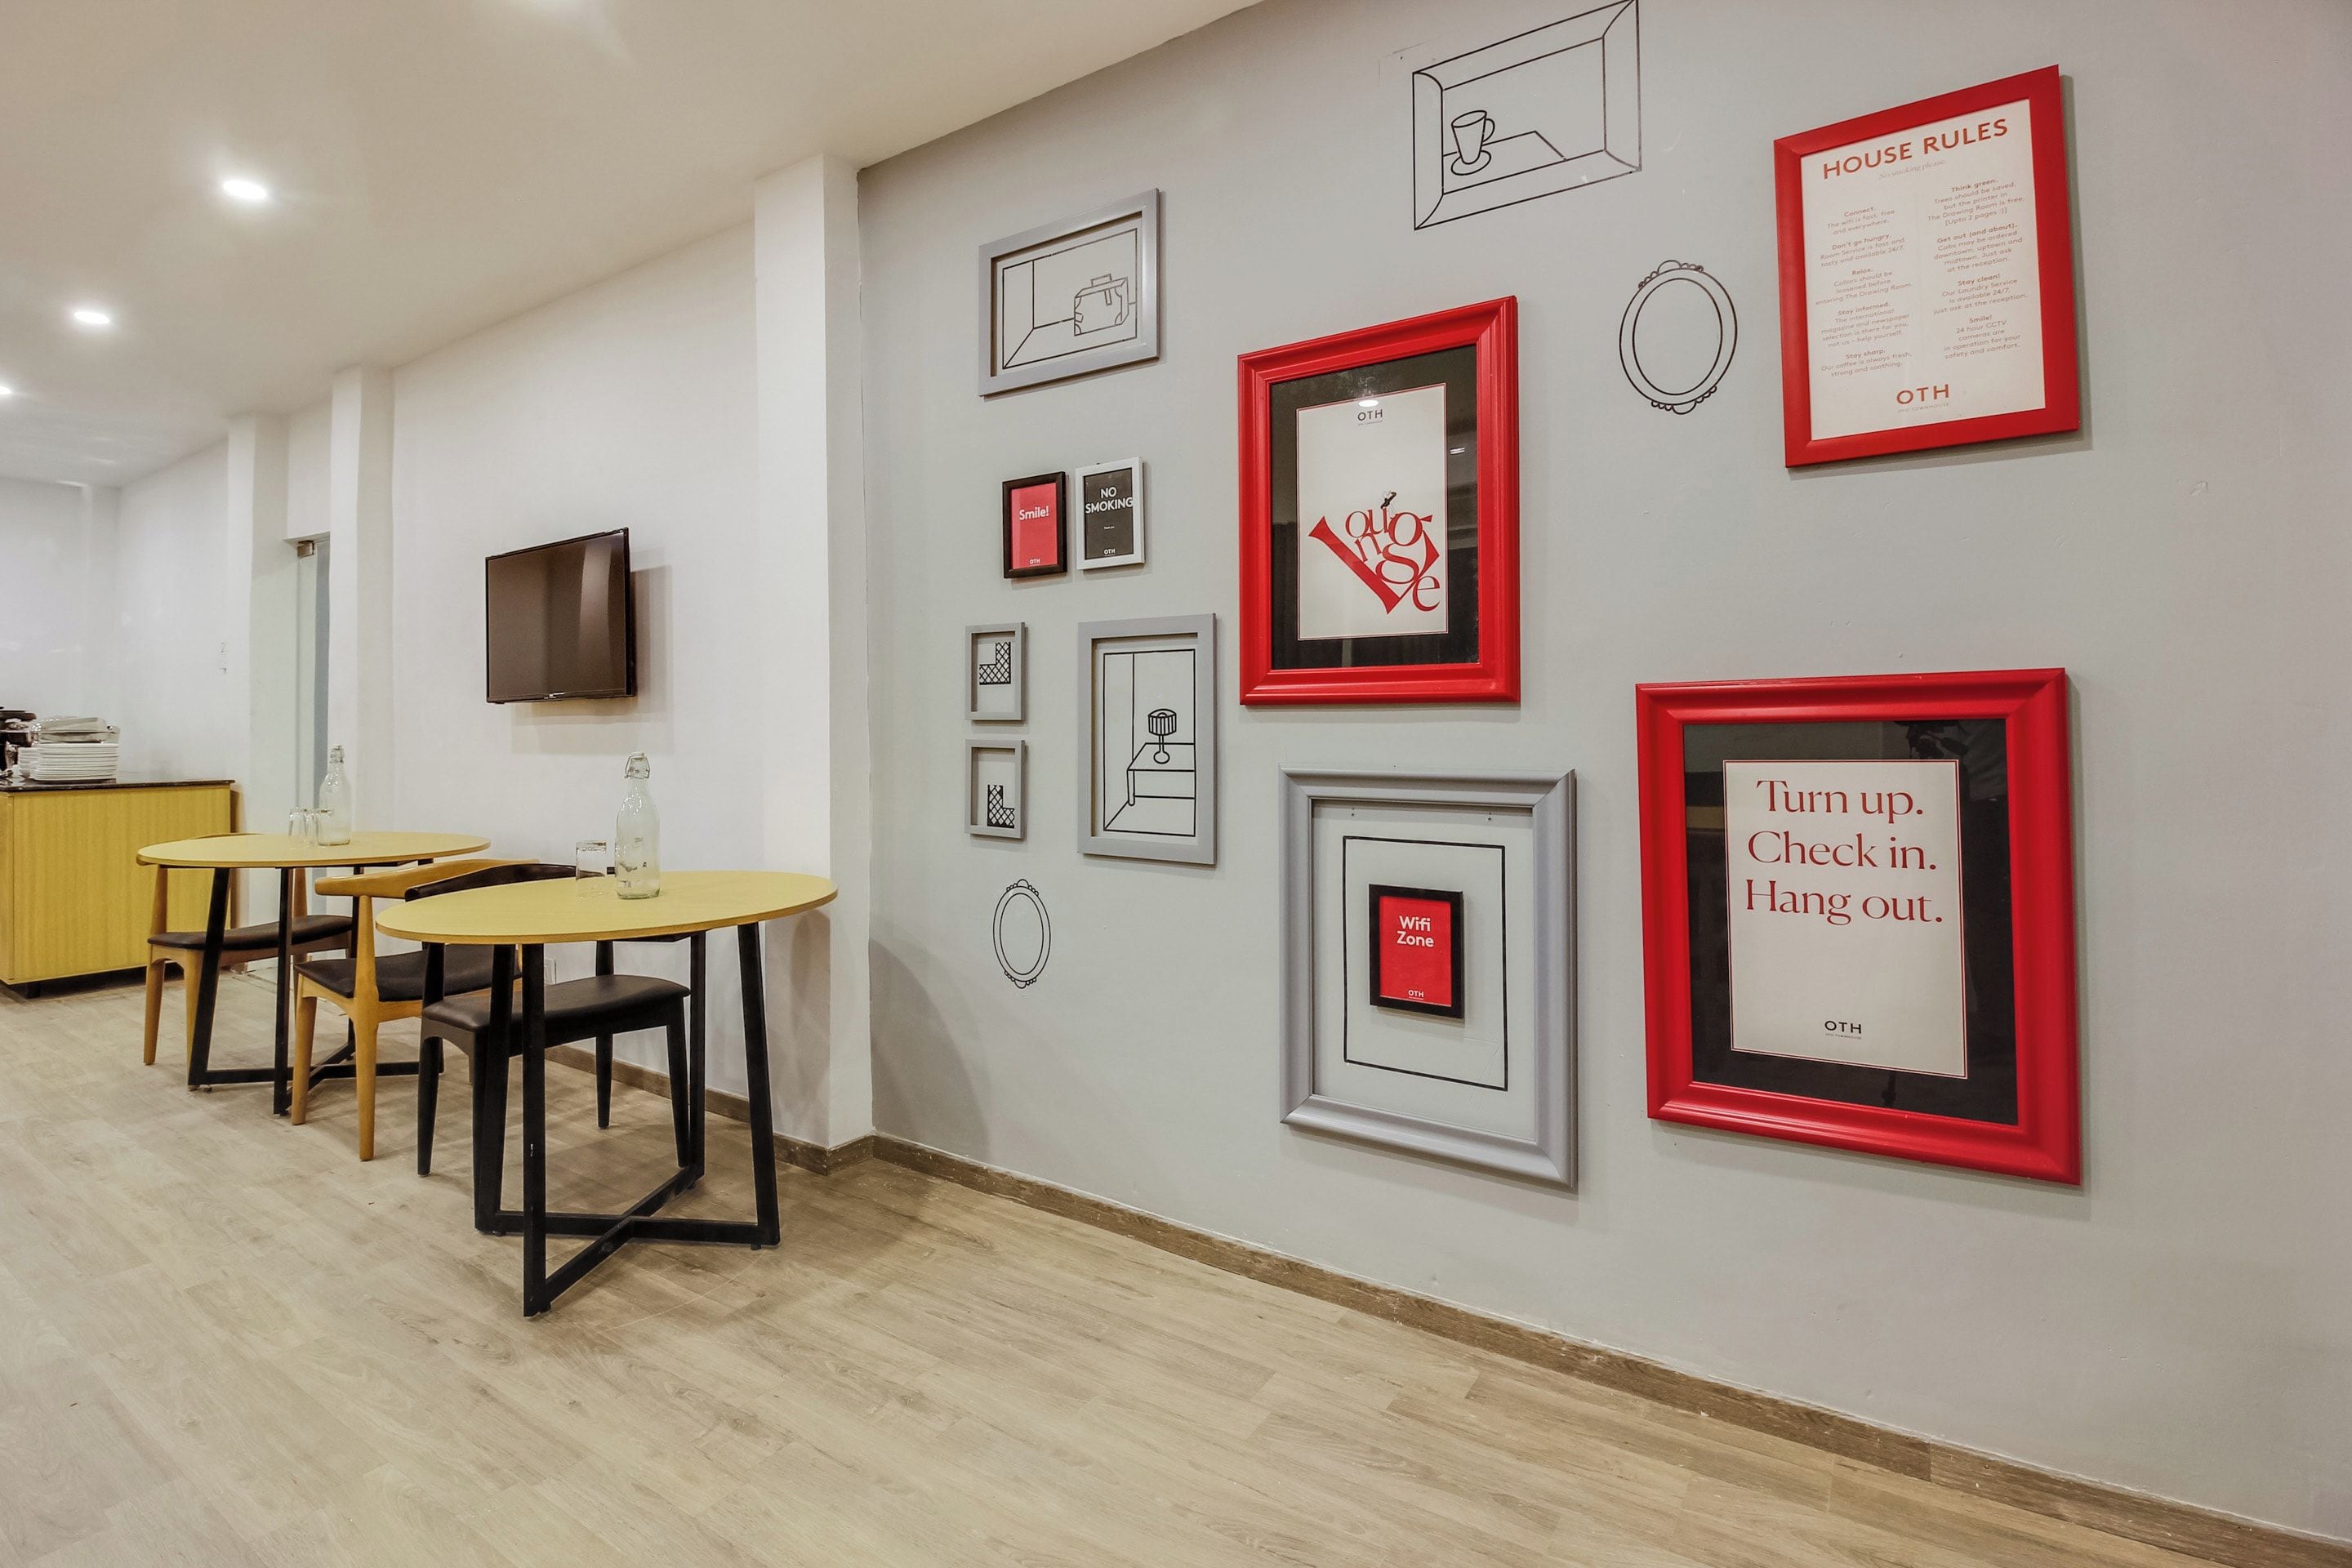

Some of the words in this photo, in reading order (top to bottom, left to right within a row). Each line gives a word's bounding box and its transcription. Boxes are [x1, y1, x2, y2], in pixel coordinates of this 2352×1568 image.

[1824, 142, 1912, 180] HOUSE
[1923, 118, 2007, 154] RULES
[1952, 185, 1971, 193] Think
[1974, 180, 1998, 188] green.
[1844, 207, 1876, 217] Connect.
[1833, 242, 1851, 250] Don't
[1864, 234, 1891, 243] hungry.
[1977, 274, 2000, 283] clean!
[1855, 302, 1891, 312] informed.
[1969, 314, 1992, 323] Smile!
[1897, 384, 1949, 404] OTH
[1358, 409, 1383, 421] OTH
[1100, 487, 1117, 498] NO
[1085, 497, 1133, 514] SMOKING
[1019, 506, 1049, 520] Smile!
[1757, 780, 1848, 814] Turn
[1861, 791, 1923, 824] up.
[1748, 831, 1878, 867] Check
[1890, 836, 1937, 871] in.
[1746, 879, 1851, 926] Hang
[1862, 895, 1943, 923] out.
[1399, 915, 1431, 931] Wifi
[1396, 931, 1434, 947] Zone
[1408, 989, 1424, 997] OTH
[1824, 1021, 1861, 1034] OTH
